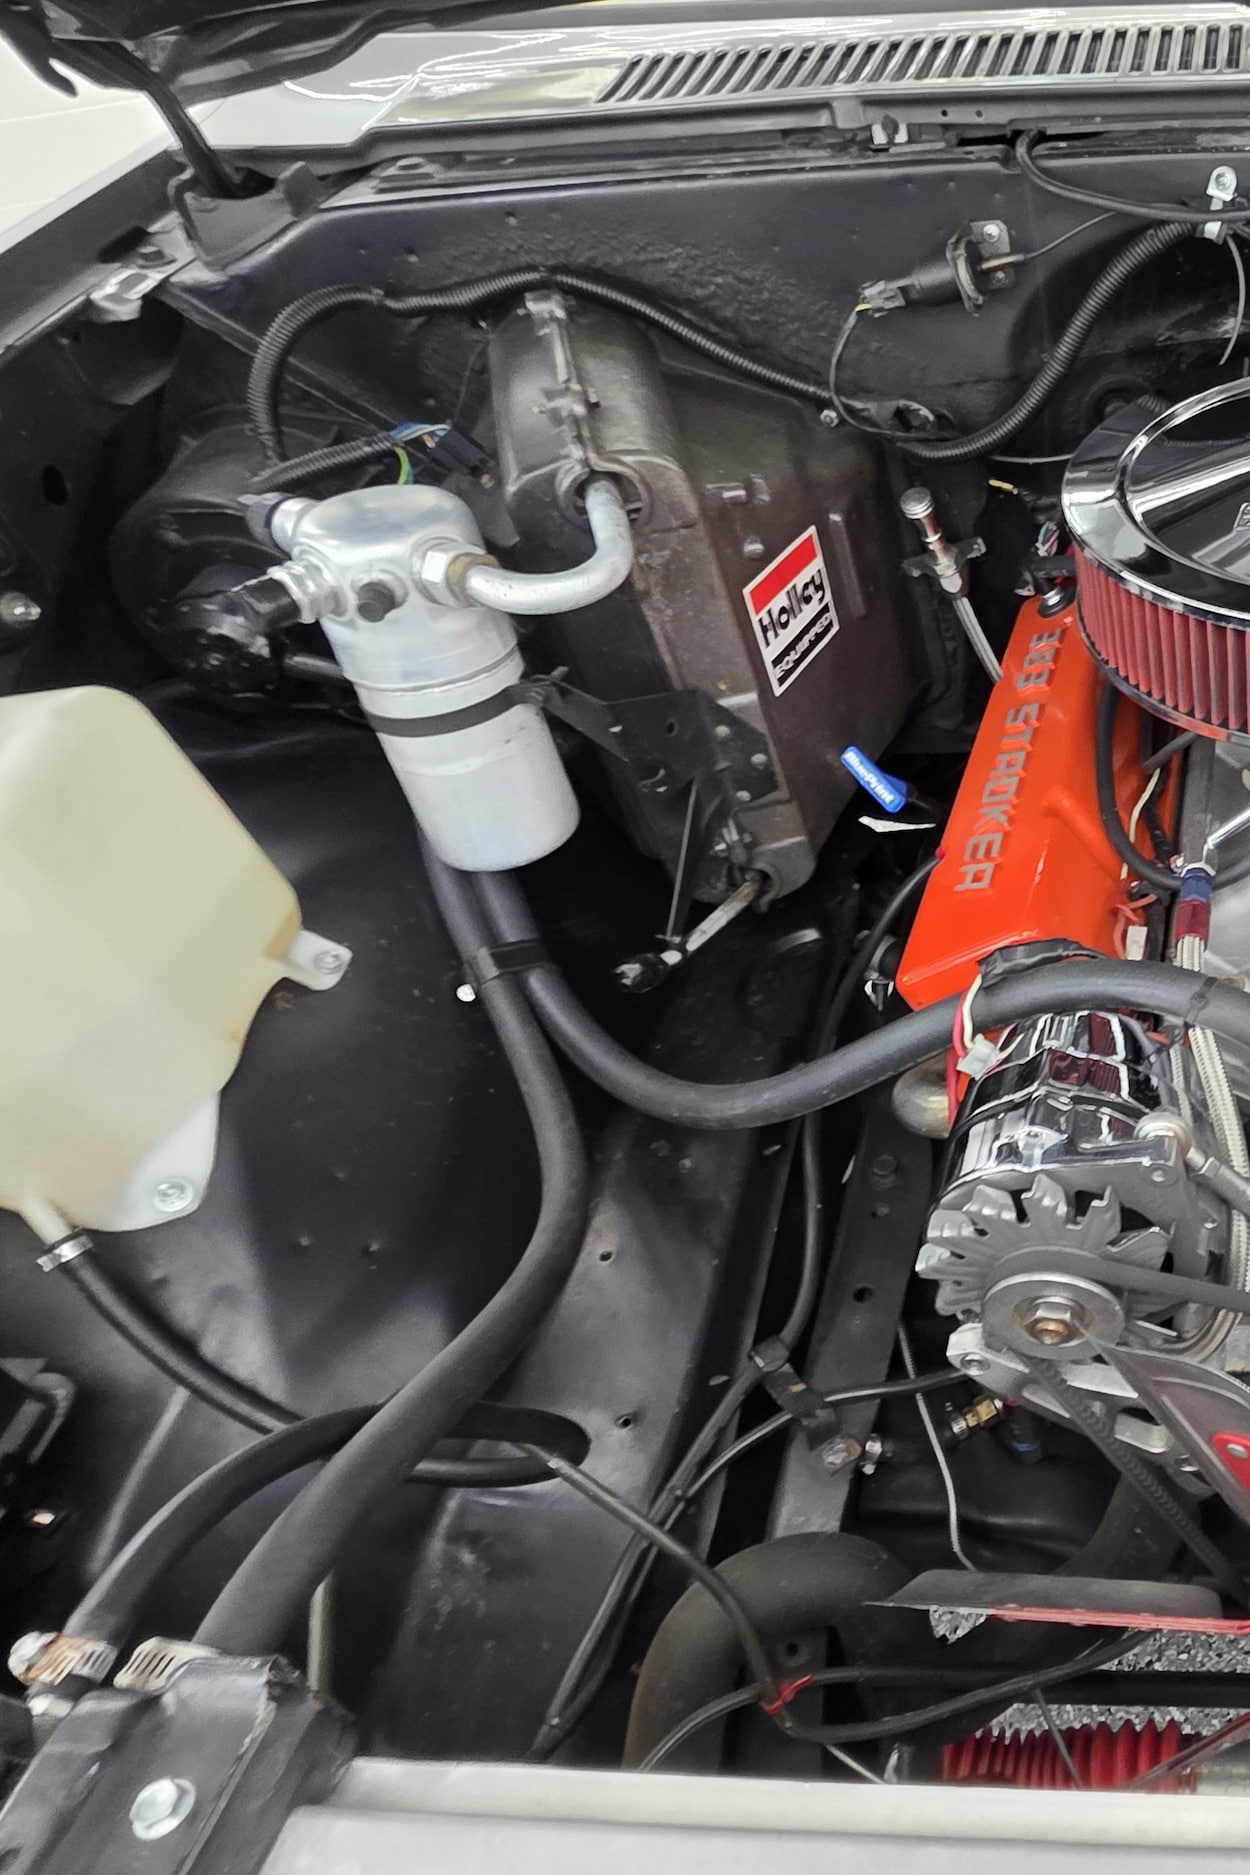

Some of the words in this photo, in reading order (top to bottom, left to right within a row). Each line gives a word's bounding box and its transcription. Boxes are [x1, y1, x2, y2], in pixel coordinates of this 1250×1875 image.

[758, 569, 826, 648] Holley
[1016, 626, 1061, 693] 383
[954, 701, 1041, 892] STROKER
